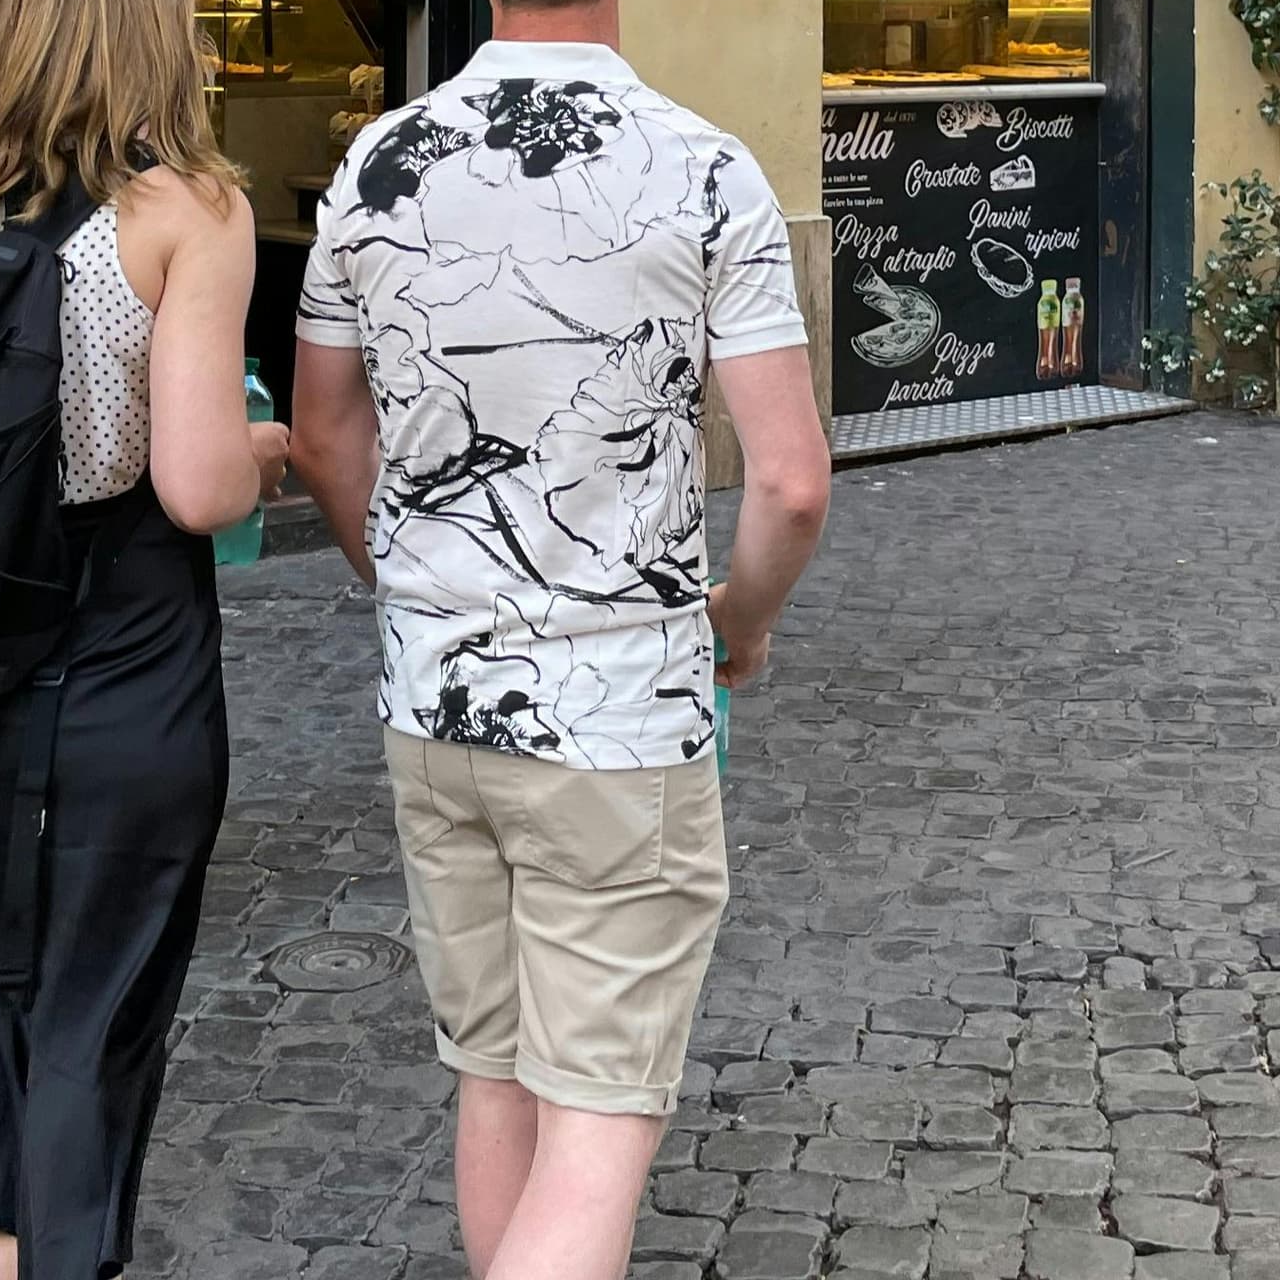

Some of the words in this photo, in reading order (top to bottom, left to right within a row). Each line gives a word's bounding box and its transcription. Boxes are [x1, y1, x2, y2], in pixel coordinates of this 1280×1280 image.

[995, 106, 1074, 152] Biscotti
[904, 158, 982, 198] Crostate
[831, 213, 900, 260] Pizza
[965, 198, 1032, 240] Panini
[1024, 226, 1081, 260] ripieni
[930, 332, 996, 377] Pizza
